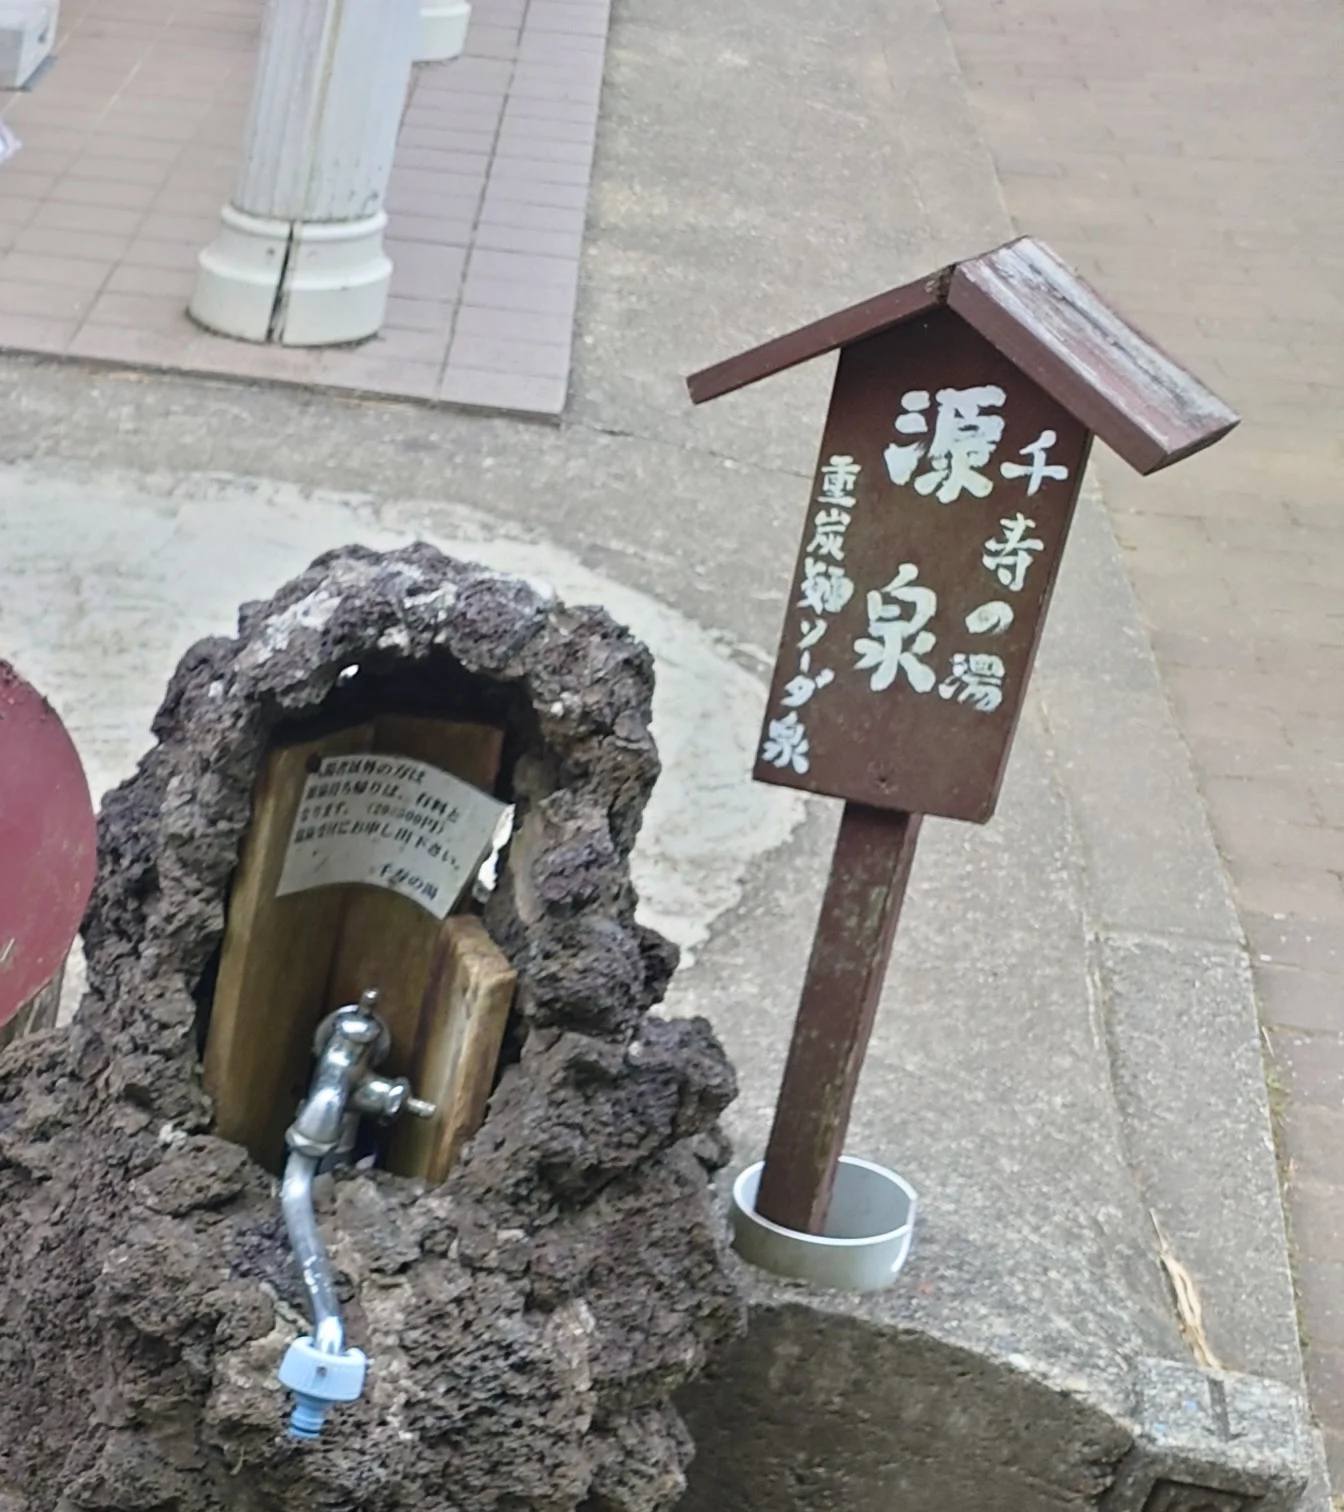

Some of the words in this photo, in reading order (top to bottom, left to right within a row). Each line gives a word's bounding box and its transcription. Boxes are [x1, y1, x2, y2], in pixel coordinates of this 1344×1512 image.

[853, 385, 1007, 693] 源泉
[938, 430, 1069, 713] 千寿の湯
